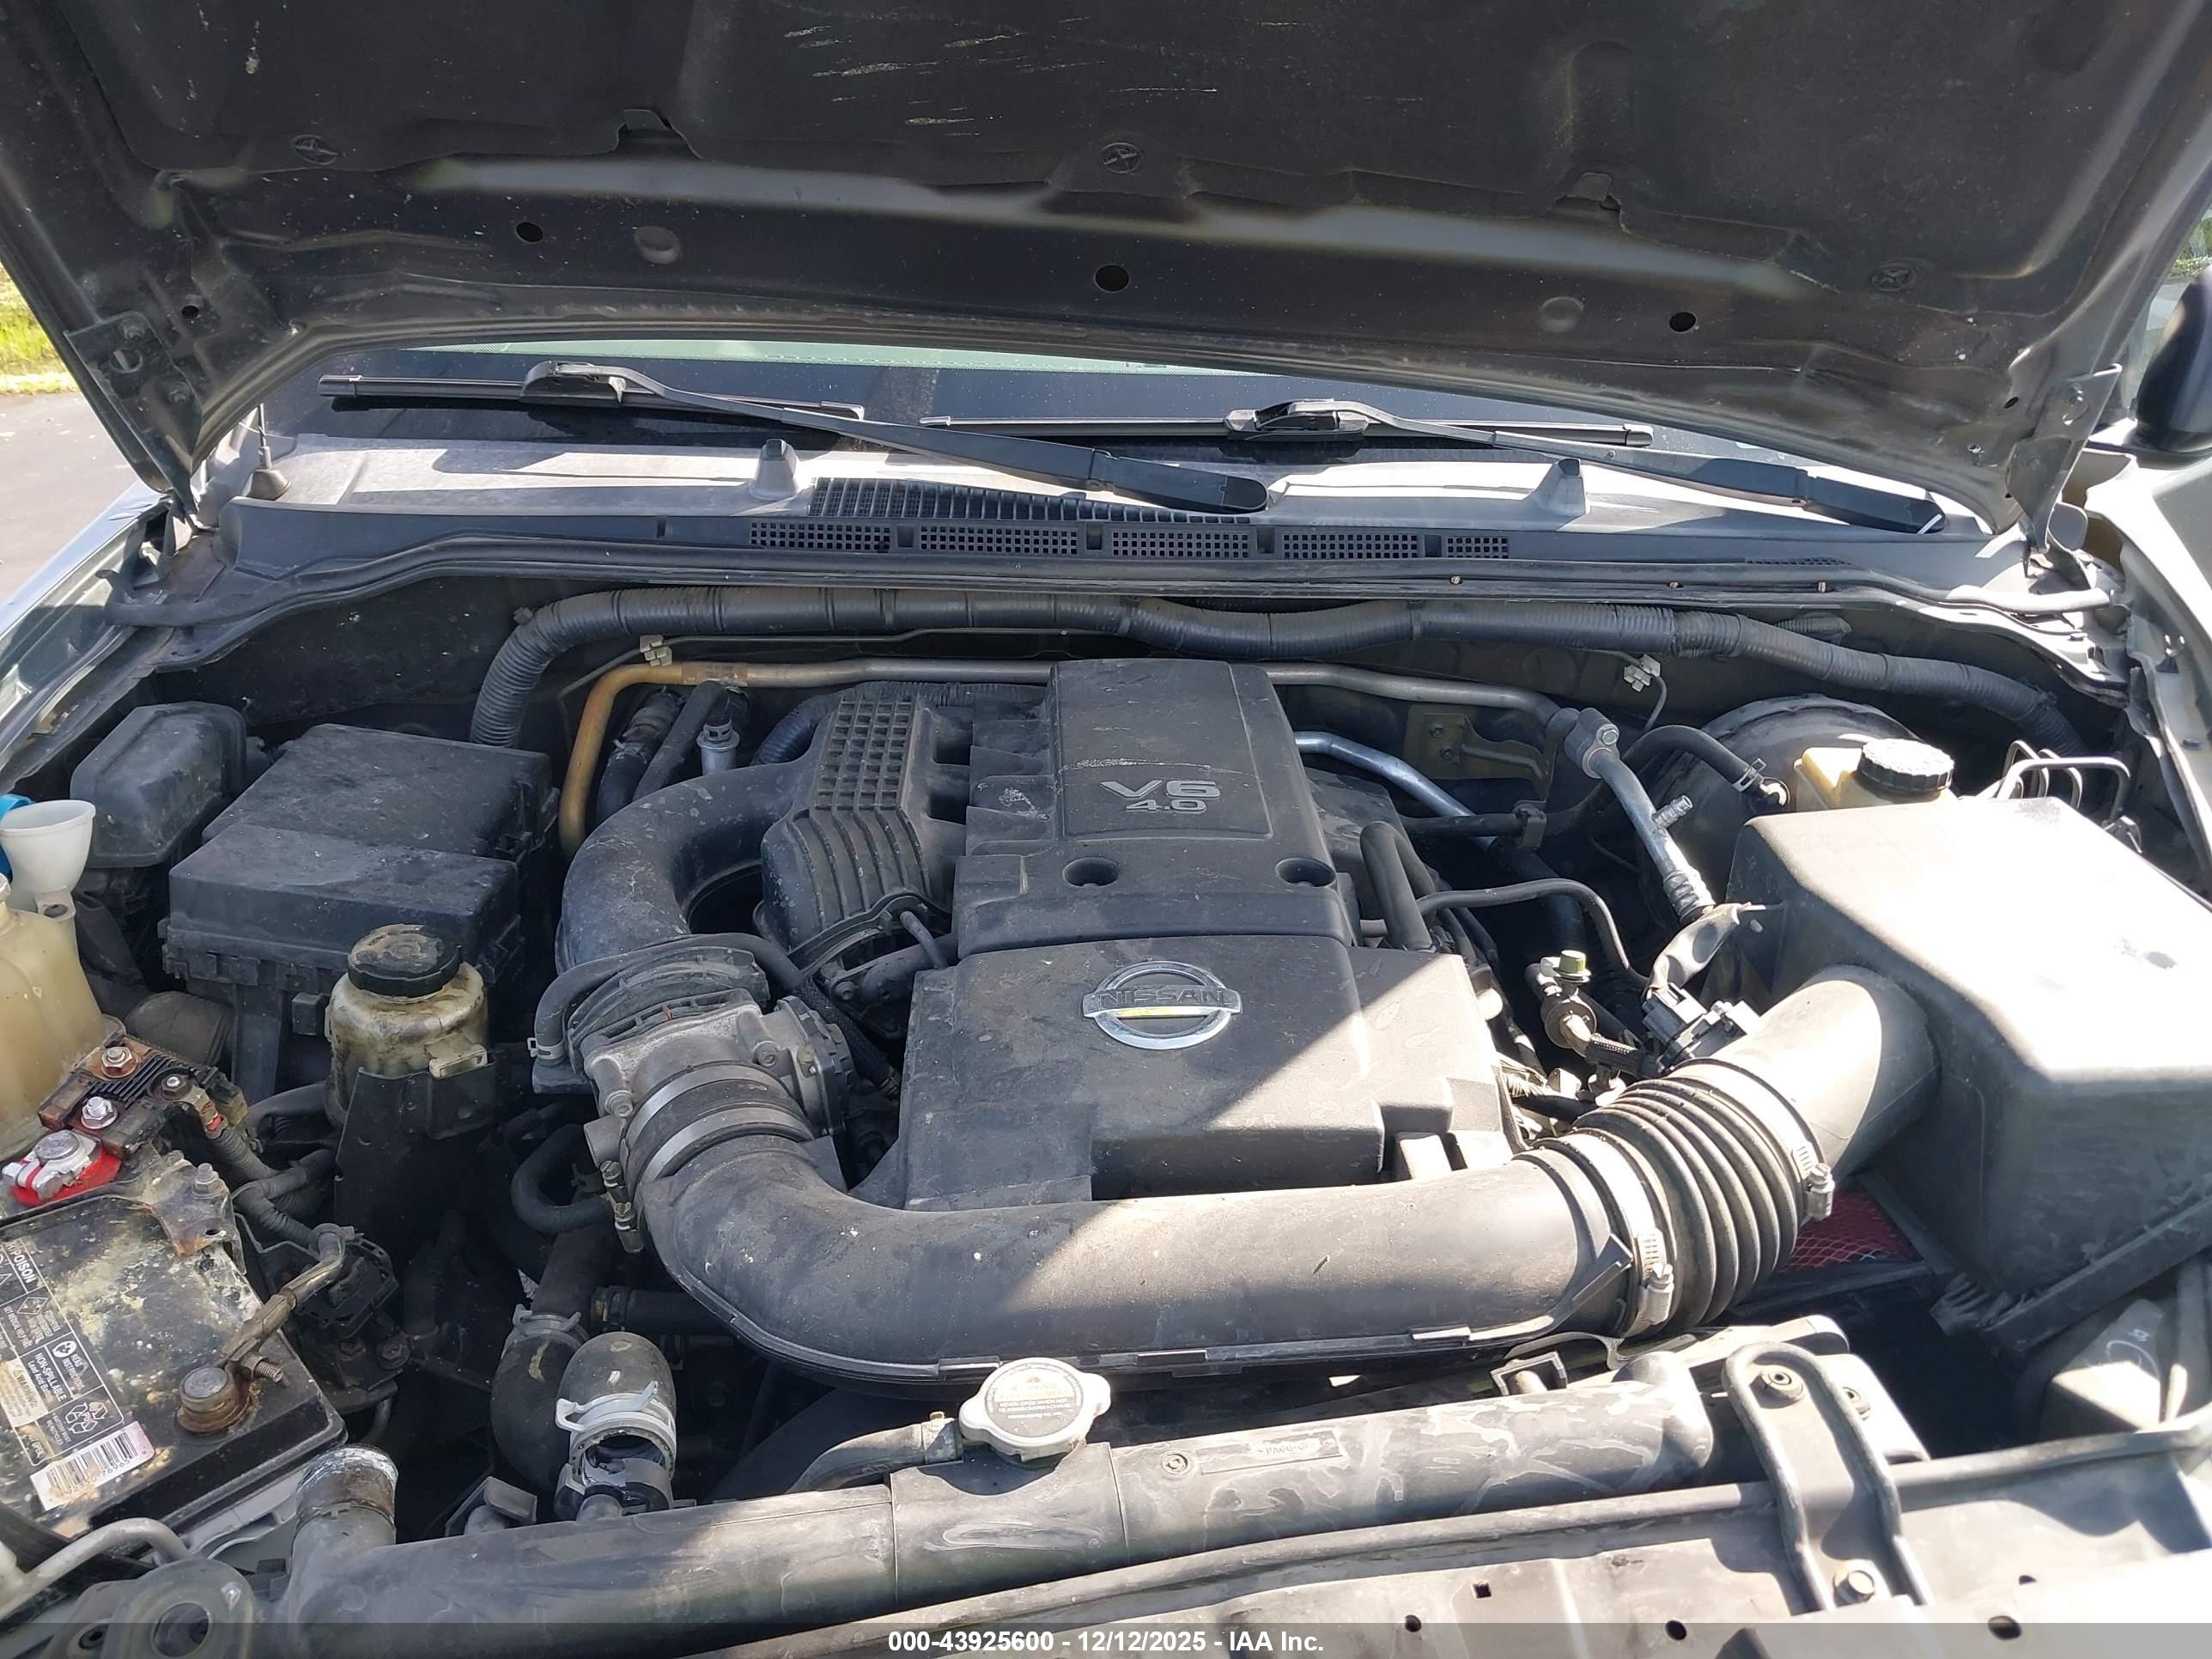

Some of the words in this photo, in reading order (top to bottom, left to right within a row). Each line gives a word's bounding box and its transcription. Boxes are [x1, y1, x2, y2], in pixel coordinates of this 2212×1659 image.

[1126, 799, 1206, 813] 4.0
[1100, 988, 1233, 1008] NISSAN
[27, 1359, 40, 1374] Lead
[70, 1352, 82, 1367] READ
[33, 1351, 66, 1402] NON-SPILLABLE
[33, 1371, 46, 1385] Acid
